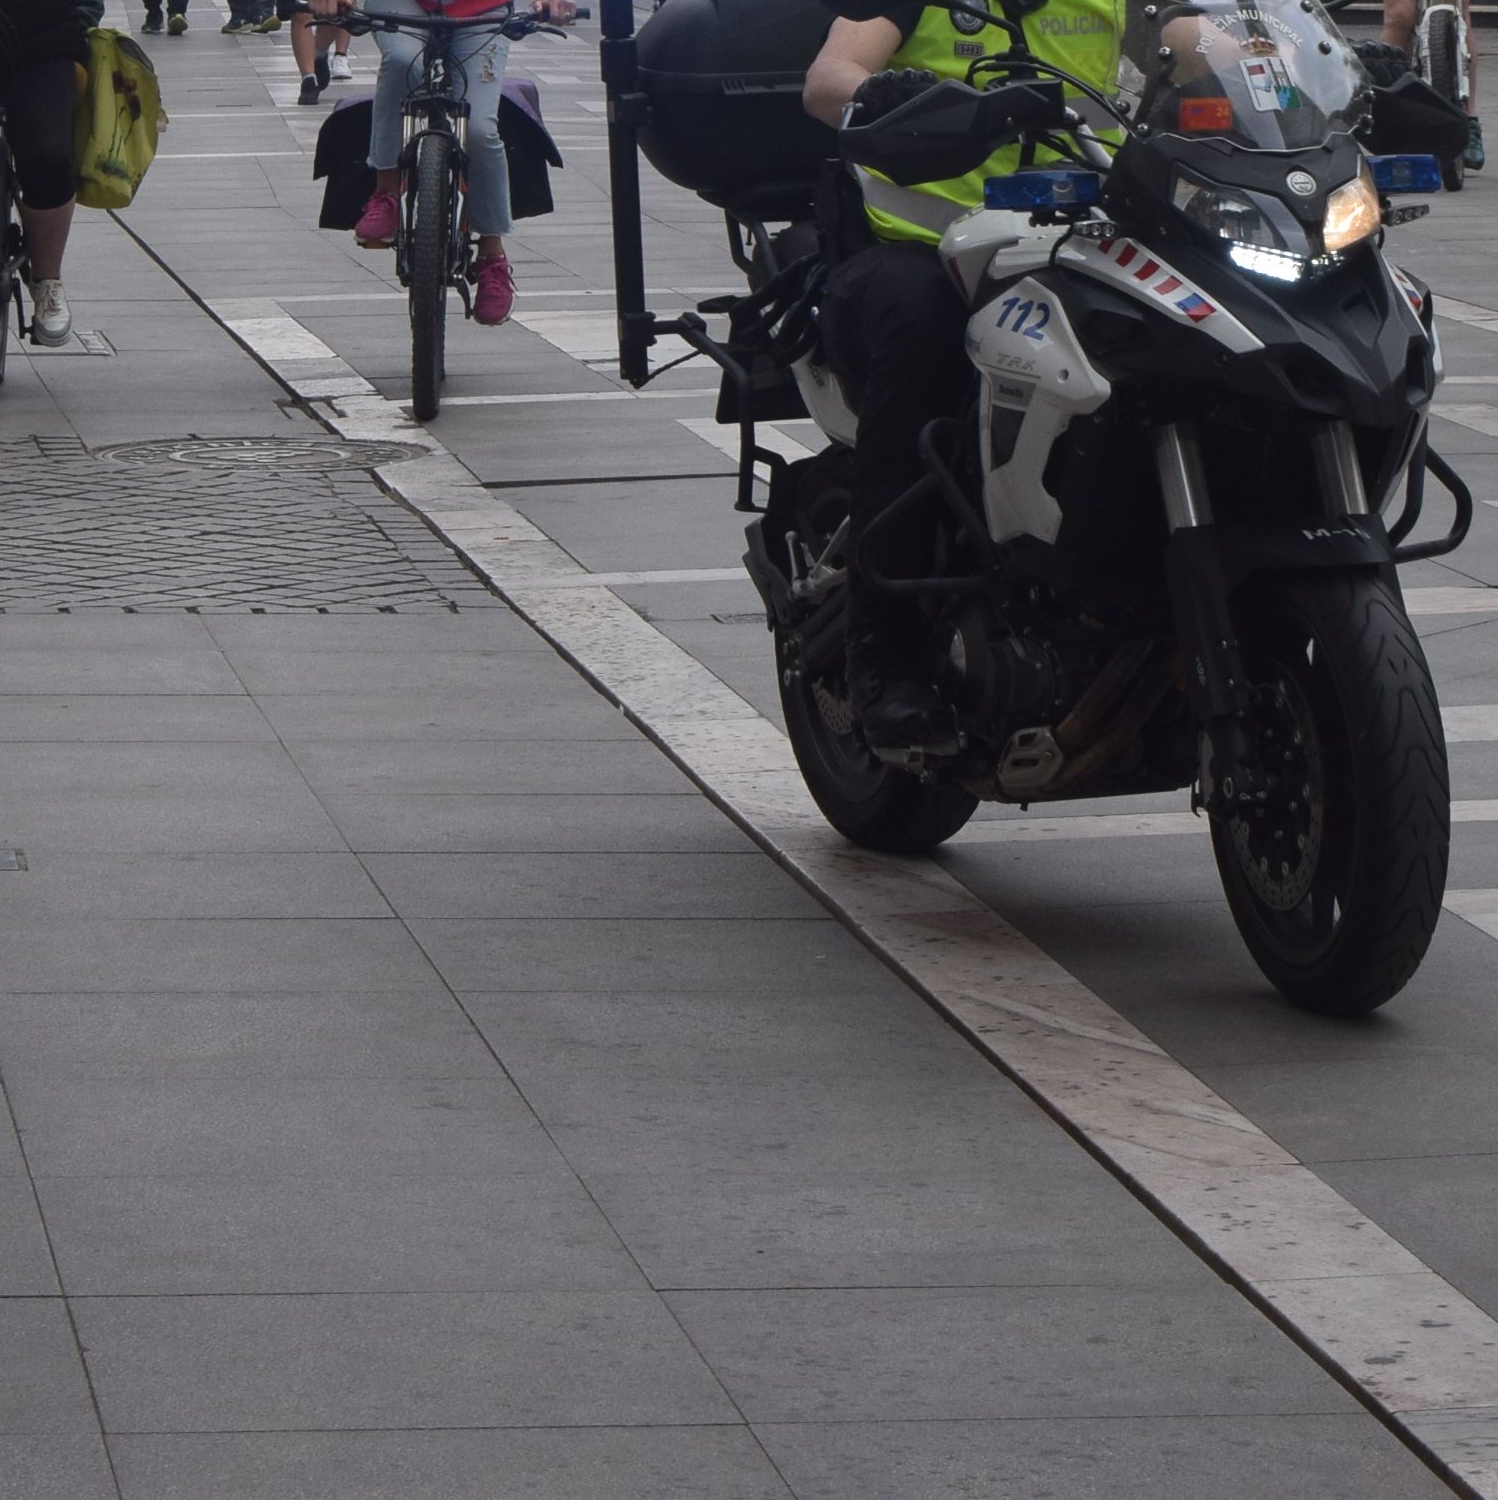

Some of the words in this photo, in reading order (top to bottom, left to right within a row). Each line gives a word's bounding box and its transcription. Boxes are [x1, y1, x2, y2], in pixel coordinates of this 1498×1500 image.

[1236, 9, 1304, 49] MUNICIPAL
[1216, 107, 1229, 117] 24
[995, 296, 1051, 341] 112
